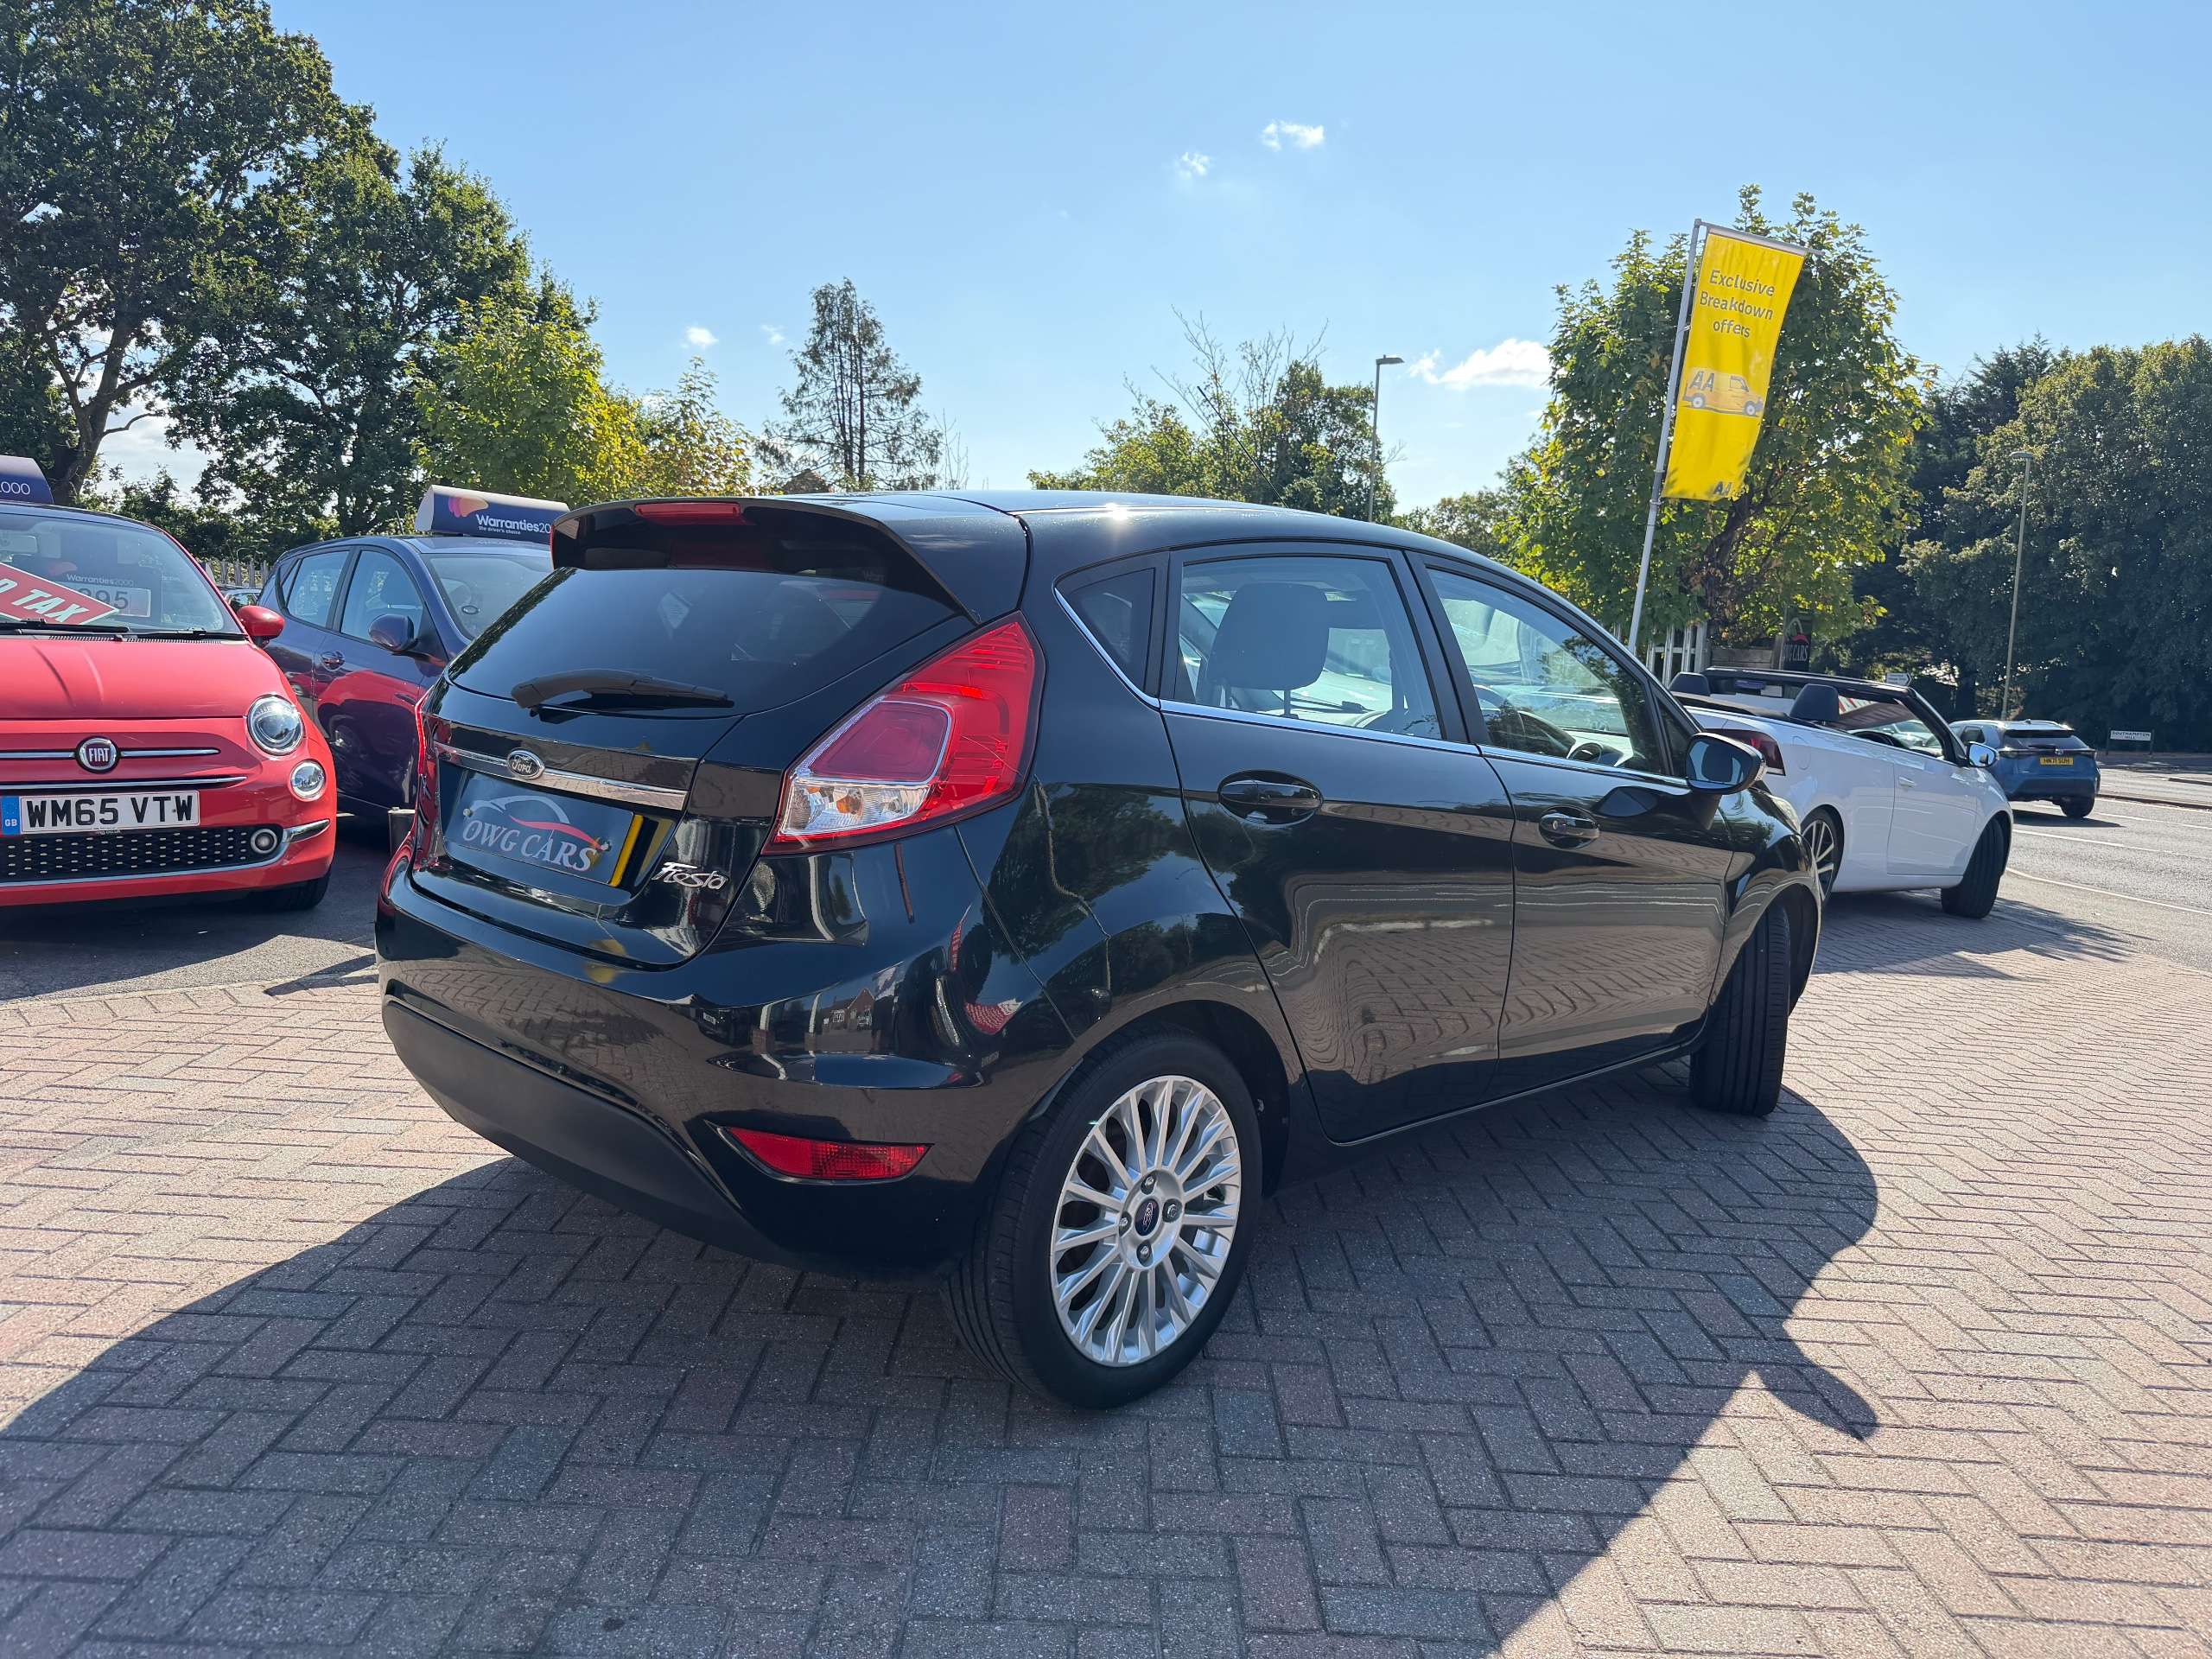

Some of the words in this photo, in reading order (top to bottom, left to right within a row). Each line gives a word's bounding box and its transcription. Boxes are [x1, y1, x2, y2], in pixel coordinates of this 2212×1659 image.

[1710, 270, 1775, 296] Exclusive
[1700, 291, 1773, 320] Breakdown
[1713, 320, 1751, 338] offers
[1689, 370, 1715, 391] AA
[0, 481, 30, 495] 000
[11, 588, 90, 622] TAX
[89, 747, 110, 762] FIAT
[512, 759, 532, 773] Ford
[4, 818, 17, 827] GB
[27, 798, 118, 828] WM65
[130, 795, 193, 823] VTW
[462, 820, 520, 852] OWG
[521, 834, 597, 872] CARS
[652, 861, 728, 890] Fiesta
